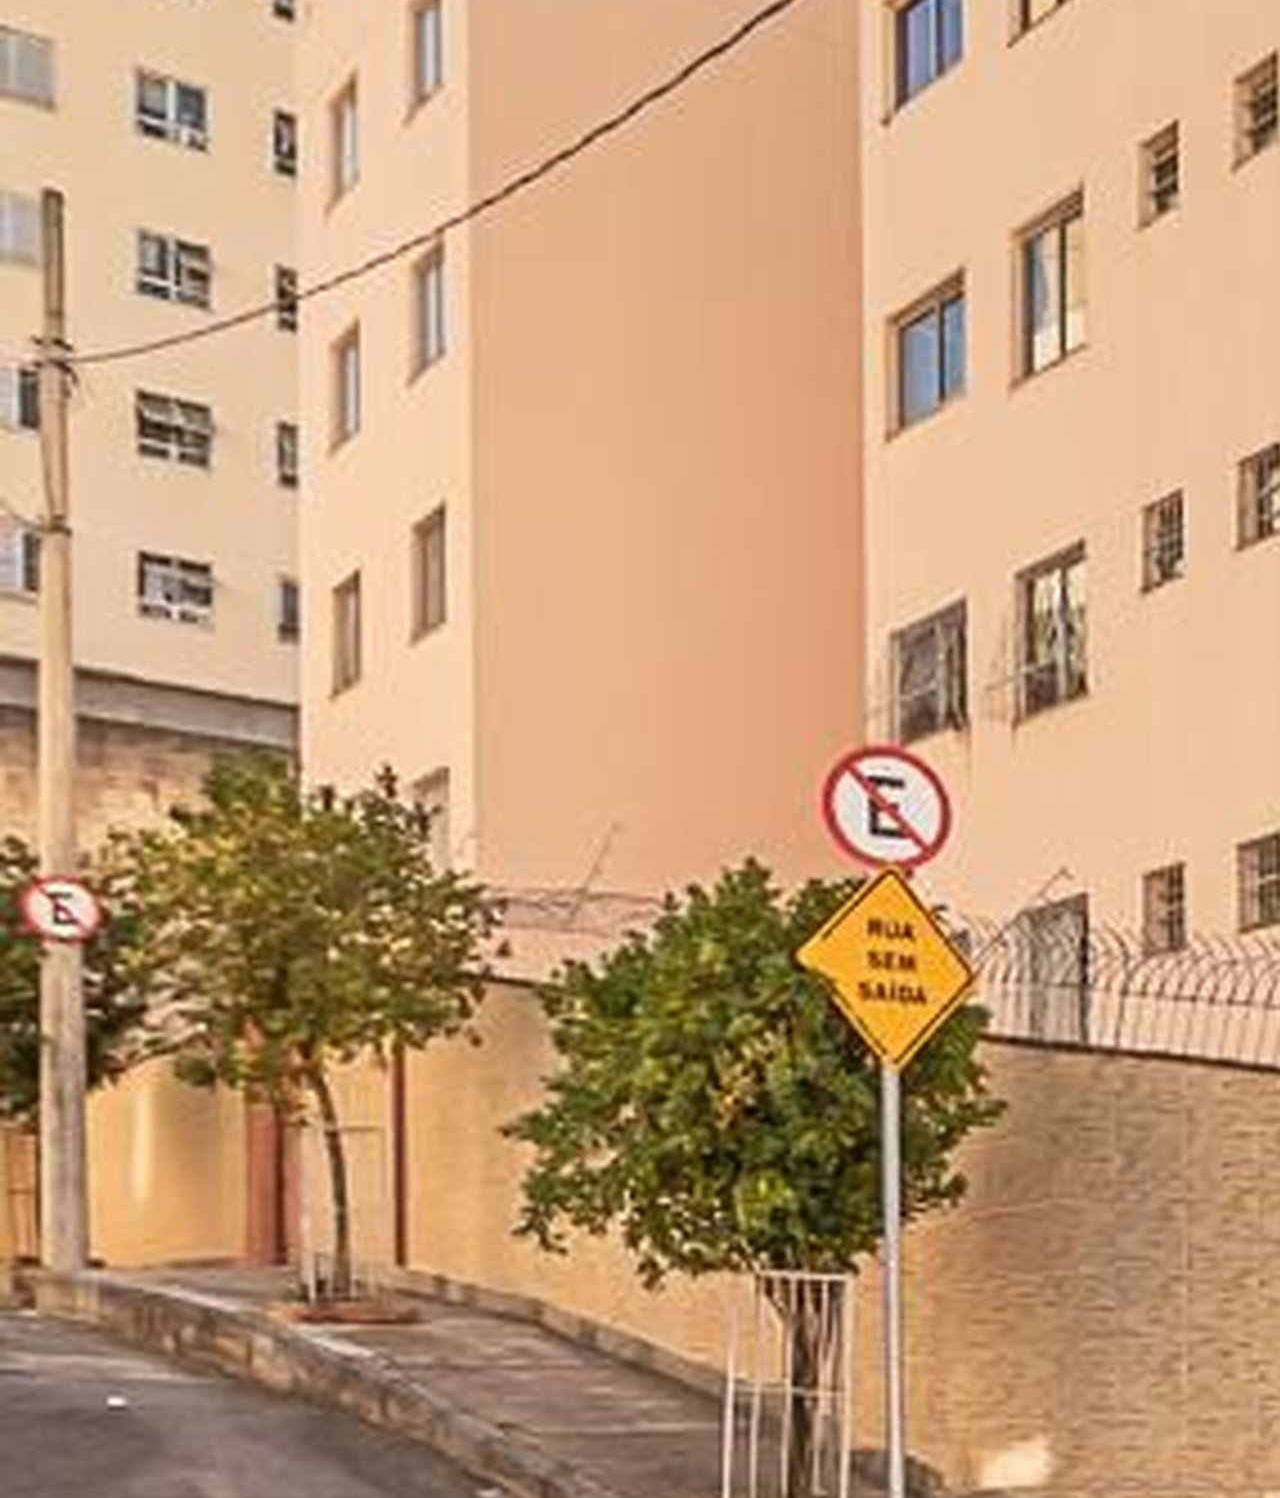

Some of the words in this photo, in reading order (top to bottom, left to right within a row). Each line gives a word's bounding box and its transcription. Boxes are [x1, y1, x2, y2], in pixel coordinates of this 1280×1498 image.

[867, 775, 907, 838] E
[50, 892, 79, 925] E
[867, 919, 914, 939] RUA
[867, 952, 916, 971] SEM
[857, 981, 928, 1005] SAÍDA
